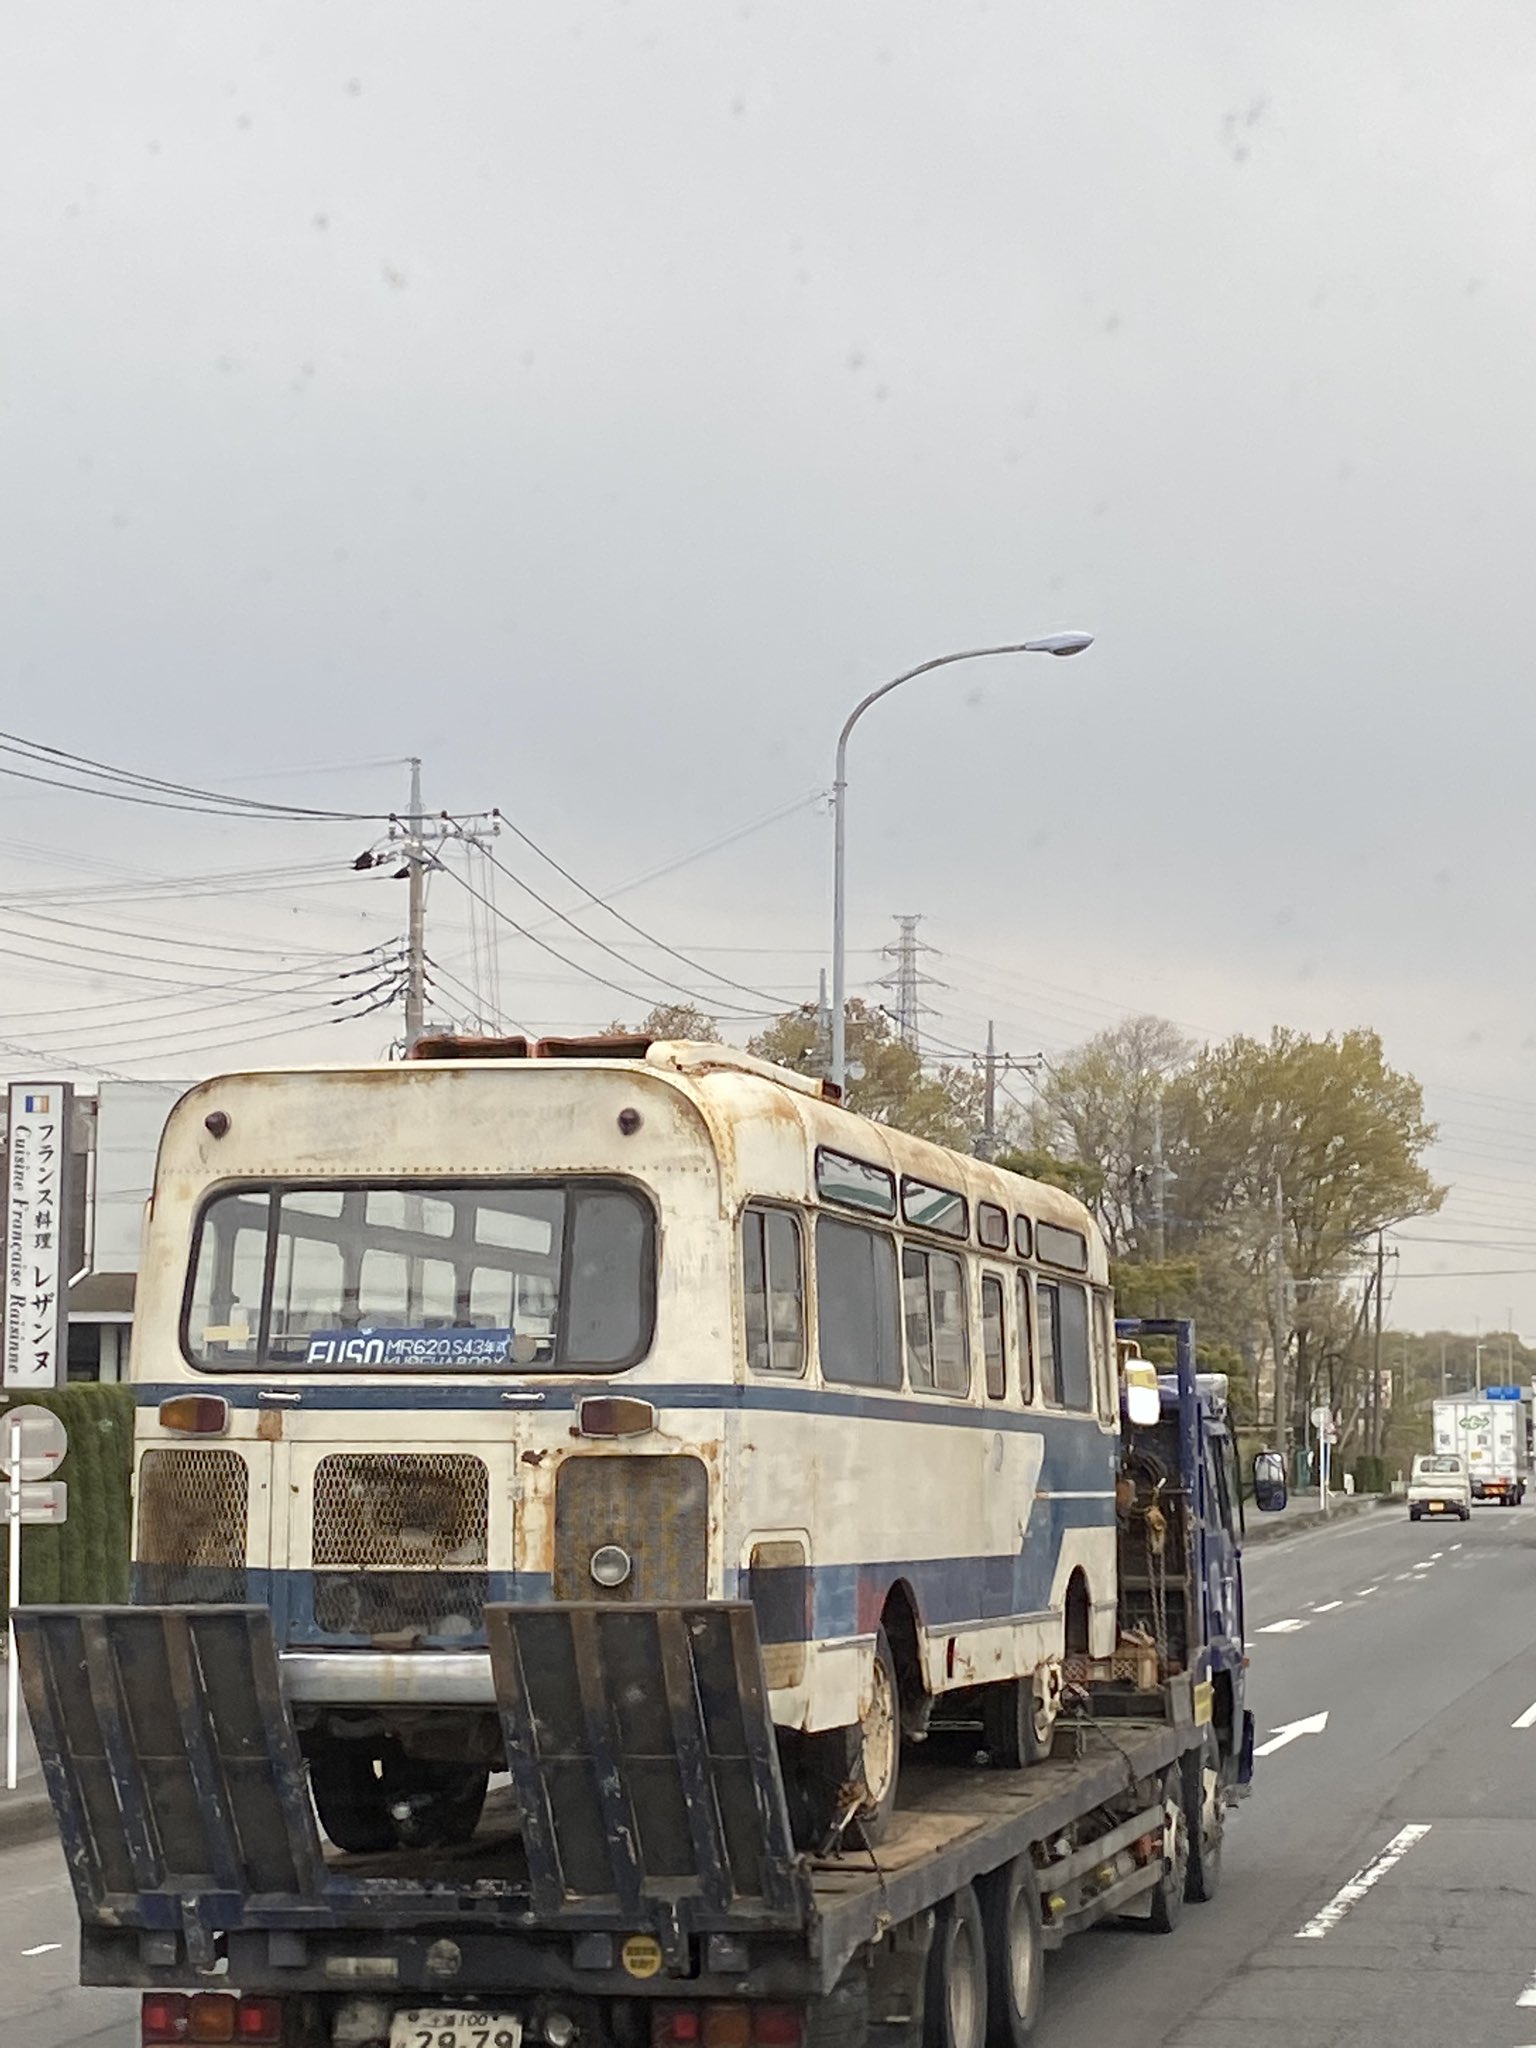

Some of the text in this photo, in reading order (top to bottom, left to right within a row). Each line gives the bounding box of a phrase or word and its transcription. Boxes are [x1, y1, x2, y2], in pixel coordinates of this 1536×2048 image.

[8, 1124, 32, 1374] Cuisine Française Raisinne
[31, 1124, 55, 1373] フランス料理 レザンヌ
[386, 1338, 450, 1356] MR620
